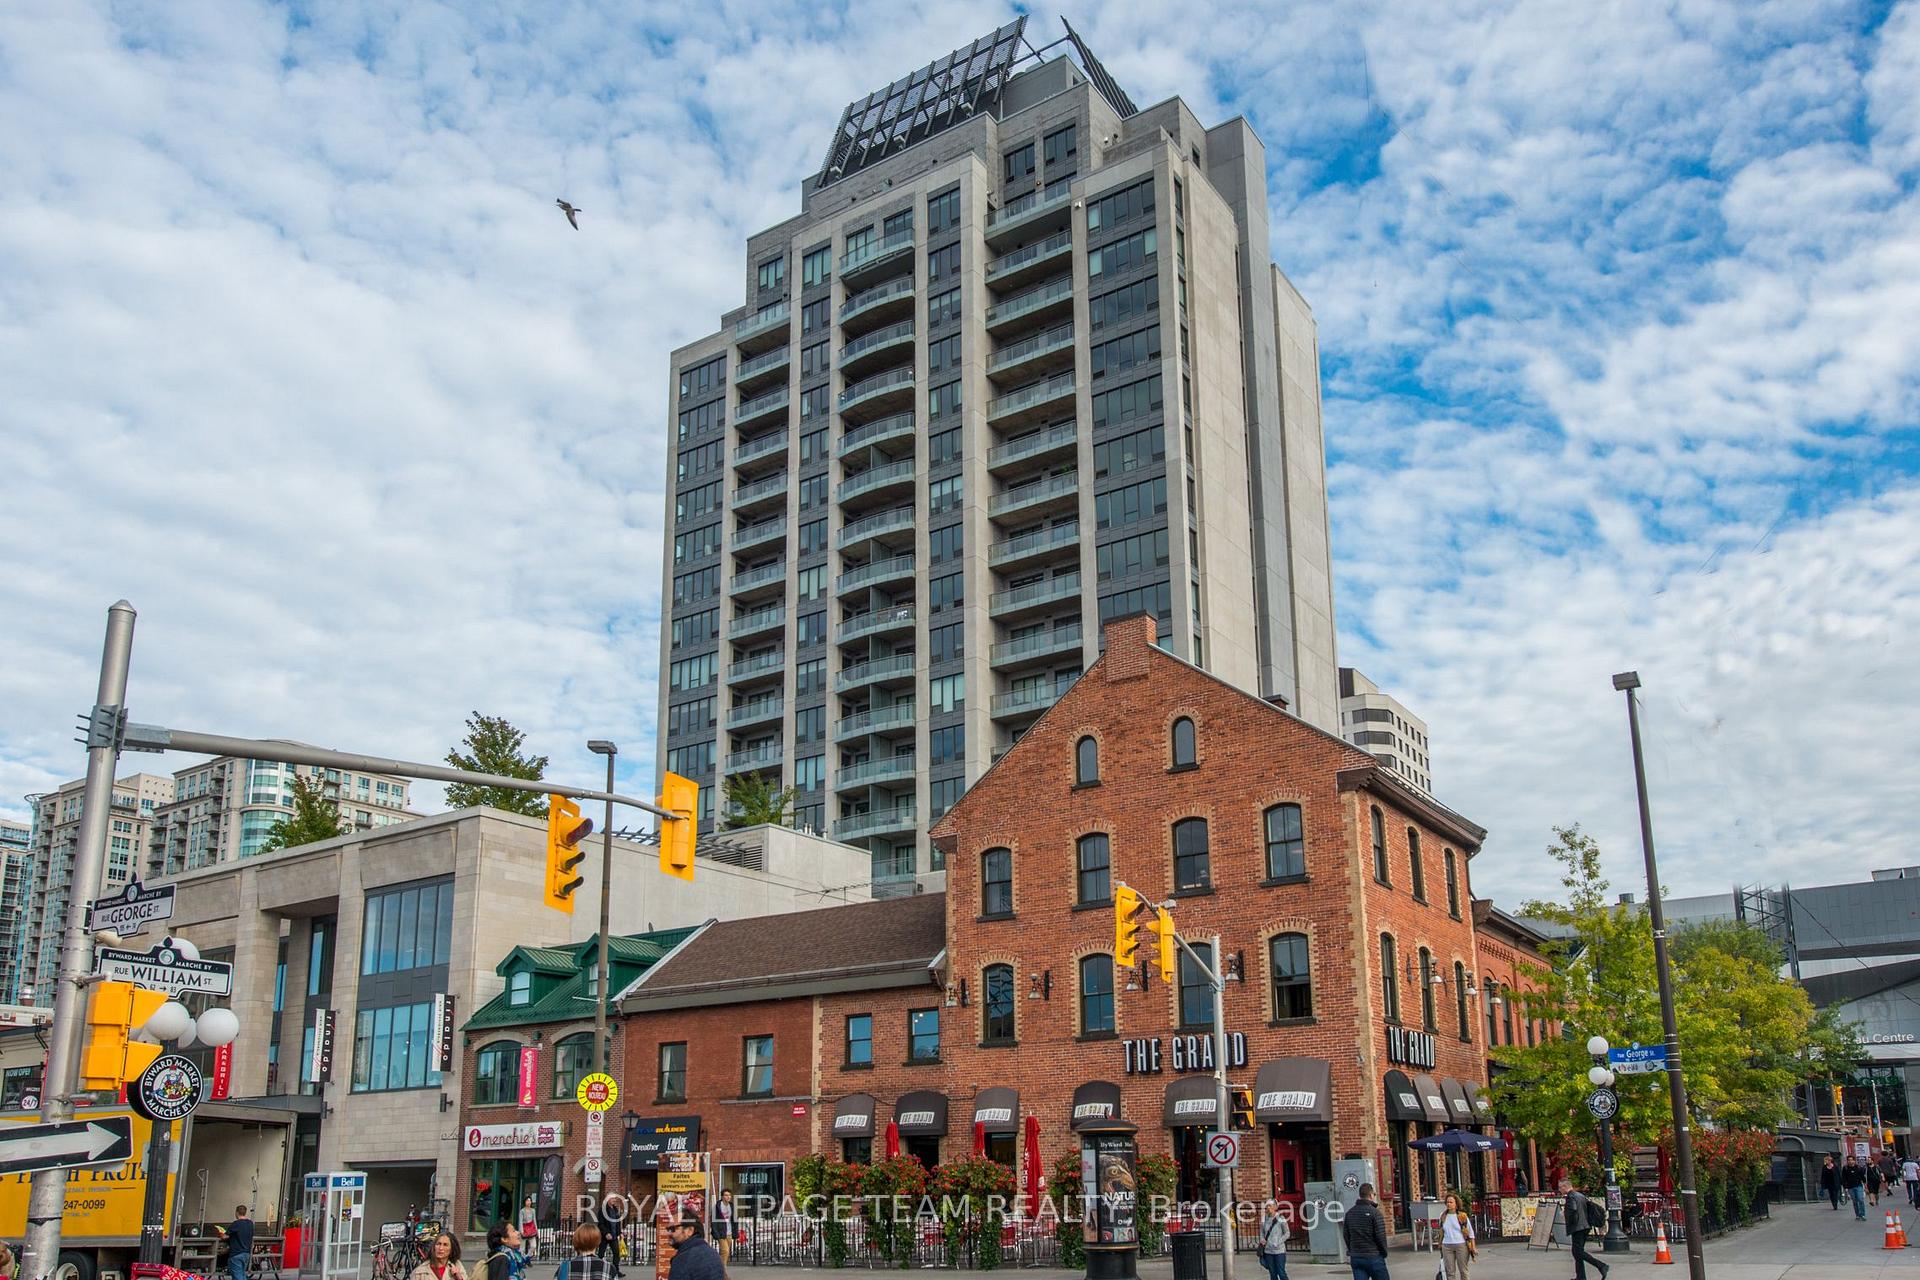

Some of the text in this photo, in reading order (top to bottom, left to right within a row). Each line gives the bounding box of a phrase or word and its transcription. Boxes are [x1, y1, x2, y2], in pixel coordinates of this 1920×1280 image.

[110, 902, 153, 923] GEORGE
[114, 966, 129, 975] RUE
[131, 964, 201, 986] WILLIAM
[1389, 1026, 1435, 1067] THE GRAND
[1873, 1032, 1914, 1043] Centre
[1123, 1038, 1160, 1072] THE
[1626, 1049, 1648, 1058] George
[144, 1059, 200, 1088] BYWARD MARKET
[183, 1100, 193, 1112] BY
[1262, 1093, 1312, 1107] THE GRAND
[482, 1127, 536, 1146] menchie's
[341, 1178, 355, 1186] Bell
